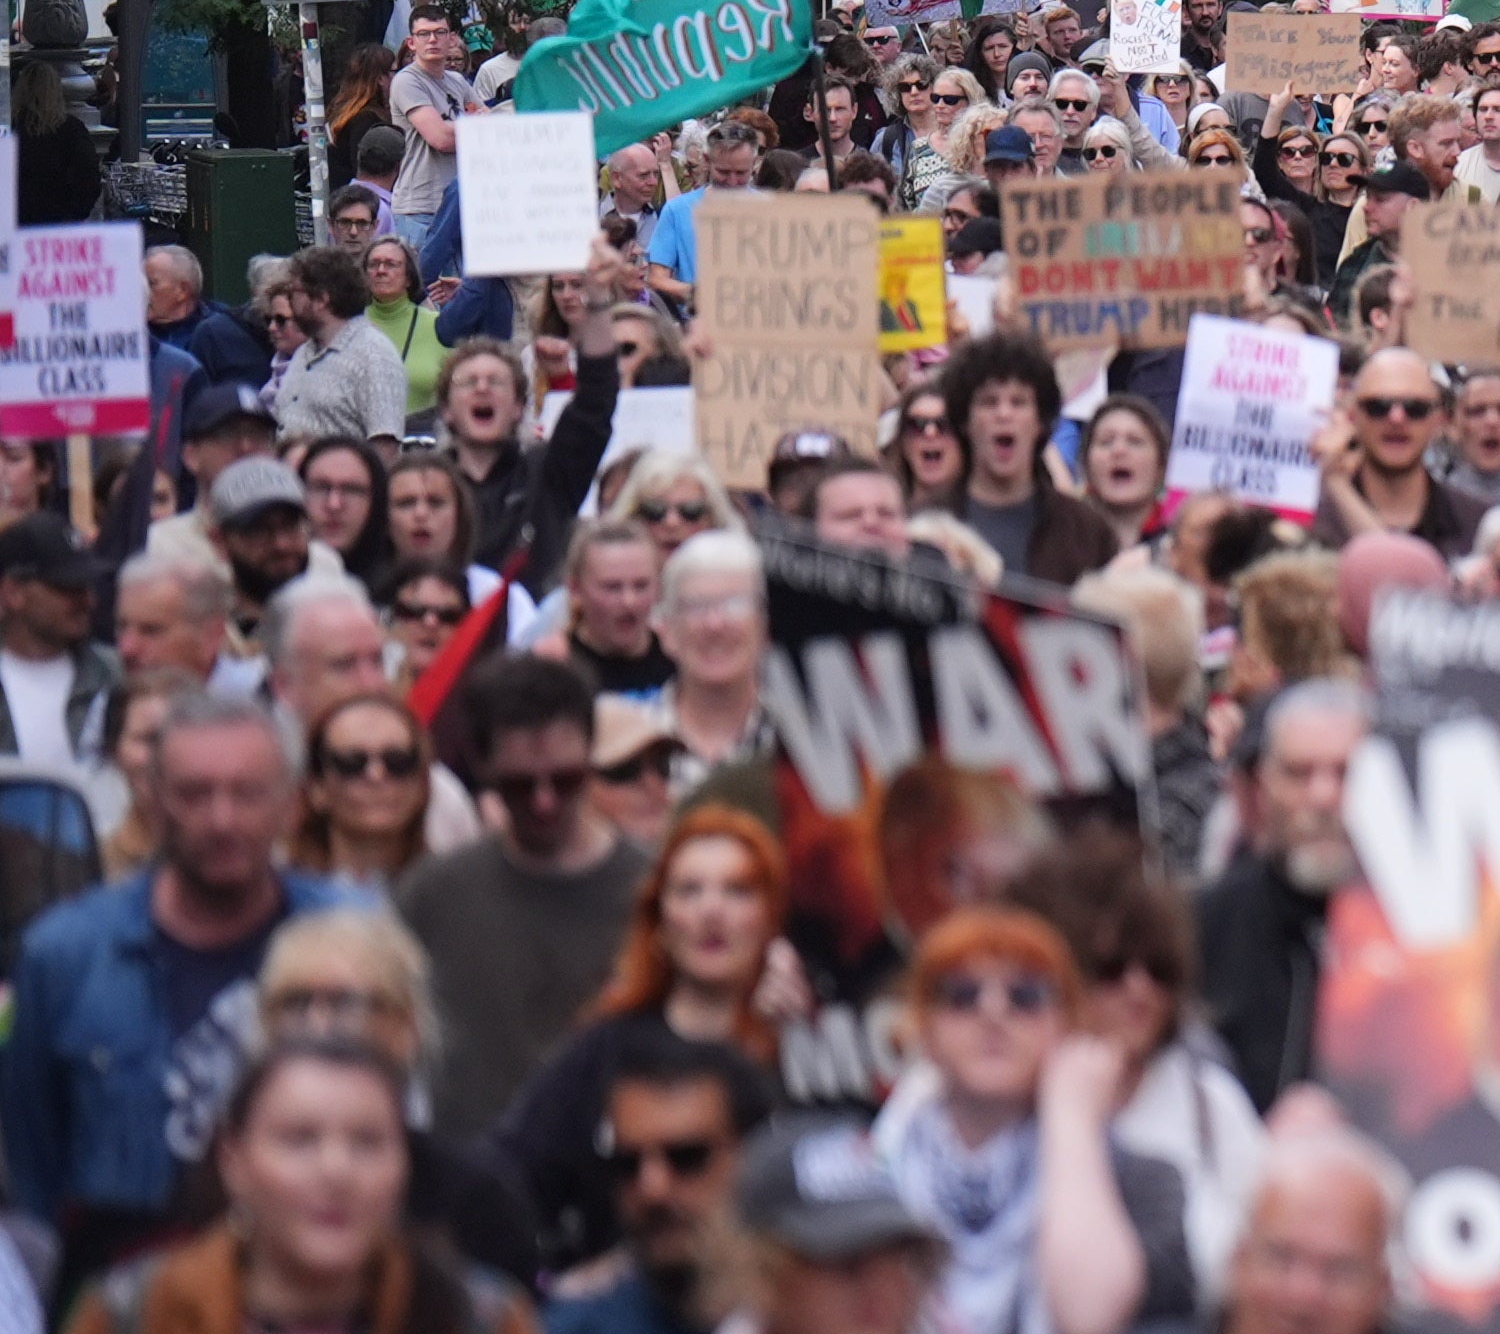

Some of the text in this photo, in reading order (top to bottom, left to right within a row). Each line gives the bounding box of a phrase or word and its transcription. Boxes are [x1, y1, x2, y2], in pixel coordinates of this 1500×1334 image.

[1119, 51, 1169, 70] Wanted
[1010, 181, 1234, 221] THE PEOPLE
[25, 235, 103, 266] STRIKE
[707, 217, 877, 269] TRUMP
[1017, 227, 1068, 257] OF
[18, 267, 114, 299] AGAINST
[1136, 255, 1240, 292] WANT
[50, 301, 88, 330] THE
[714, 274, 860, 332] BRINGS
[1022, 296, 1150, 336] TRUMP
[38, 366, 106, 395] CLASS
[694, 351, 871, 410] DIVISION
[759, 613, 1153, 817] WAR
